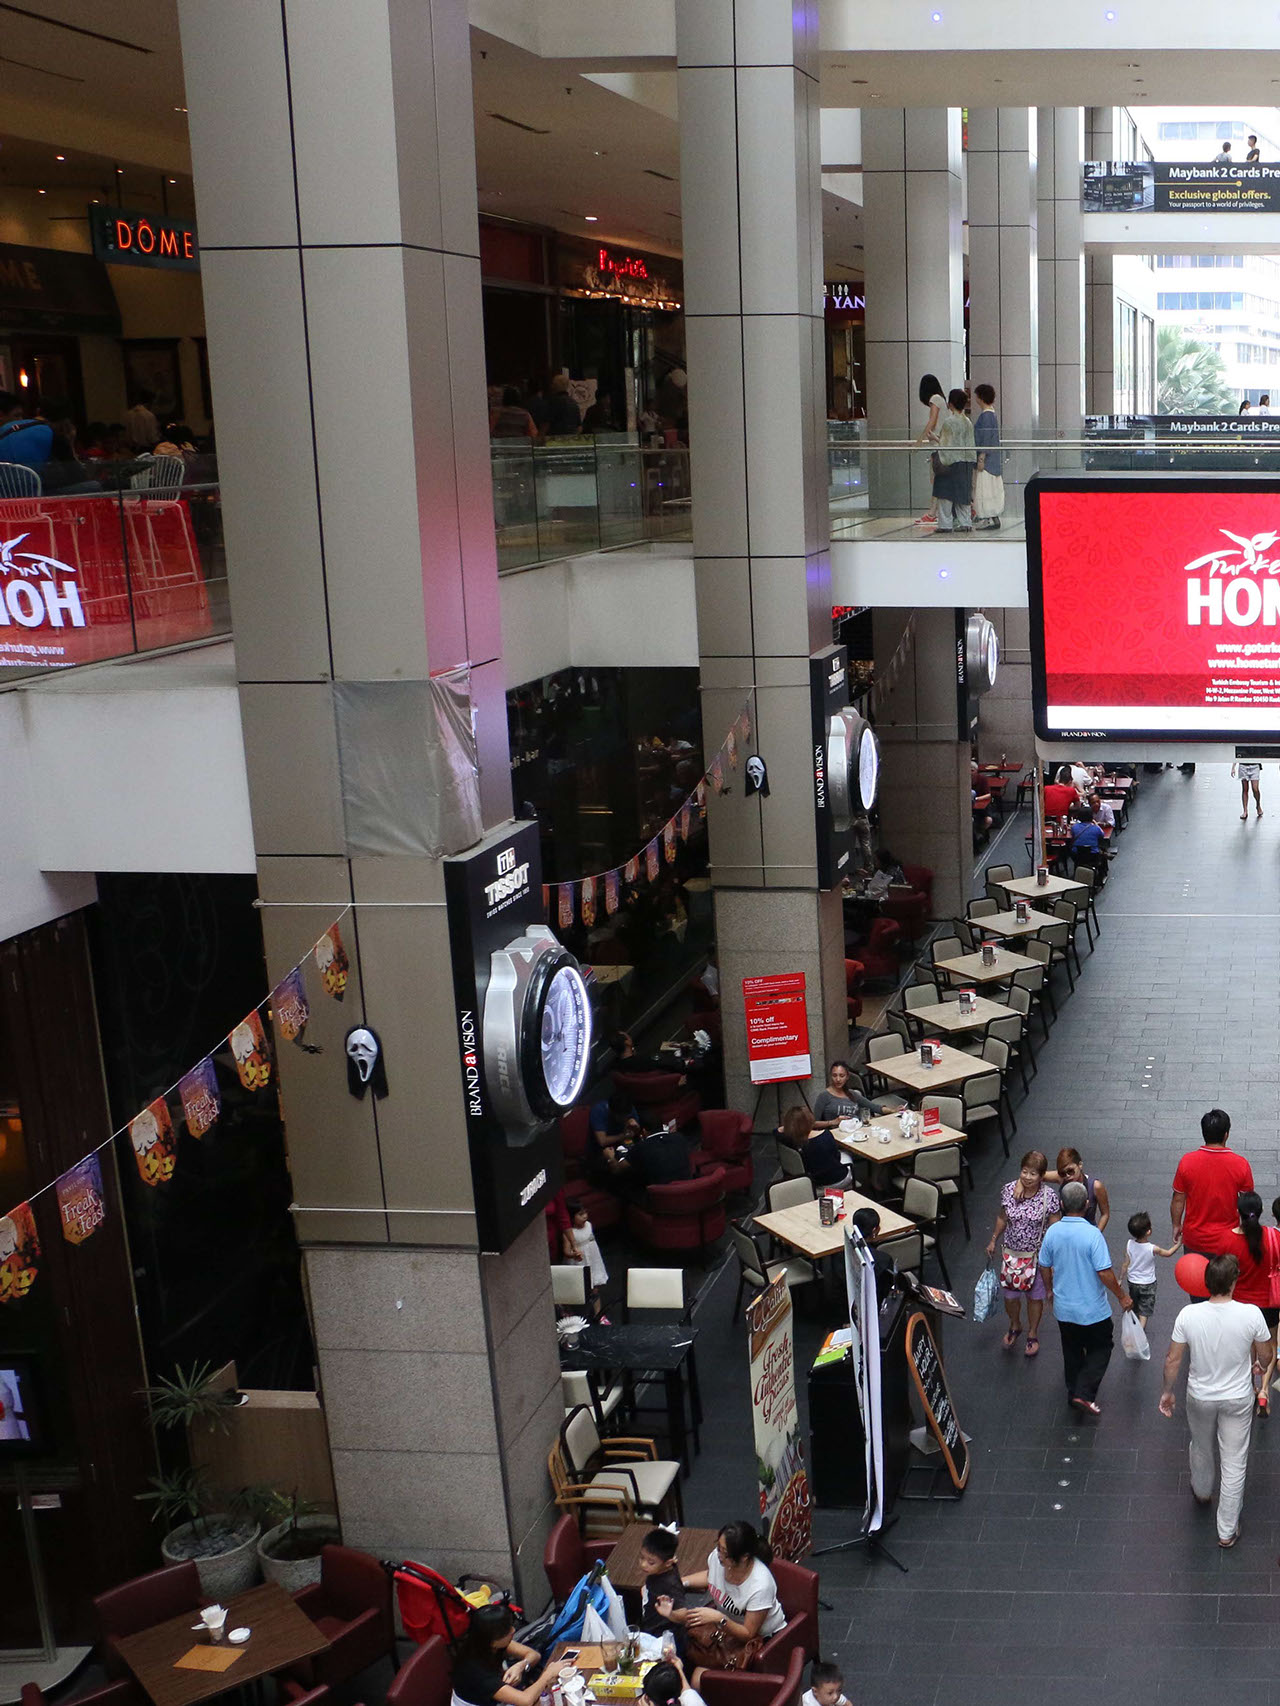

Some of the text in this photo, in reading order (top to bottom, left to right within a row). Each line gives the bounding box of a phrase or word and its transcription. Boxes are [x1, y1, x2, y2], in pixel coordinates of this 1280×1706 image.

[1169, 167, 1219, 180] Maybank
[1221, 168, 1227, 178] 2
[1229, 167, 1260, 178] Cards
[1169, 190, 1271, 201] Exclusive global offers.
[1239, 201, 1264, 209] privileges.
[1170, 422, 1219, 434] Maybank
[1221, 422, 1227, 432] 2
[1229, 422, 1260, 432] Cards
[484, 862, 530, 907] TISSOT
[750, 1017, 764, 1025] 10%
[751, 1034, 799, 1045] Complimentary
[460, 1010, 482, 1117] BRANDaVISION
[185, 1089, 213, 1120] Freak
[62, 1188, 98, 1224] Freak
[79, 1199, 105, 1234] Feast
